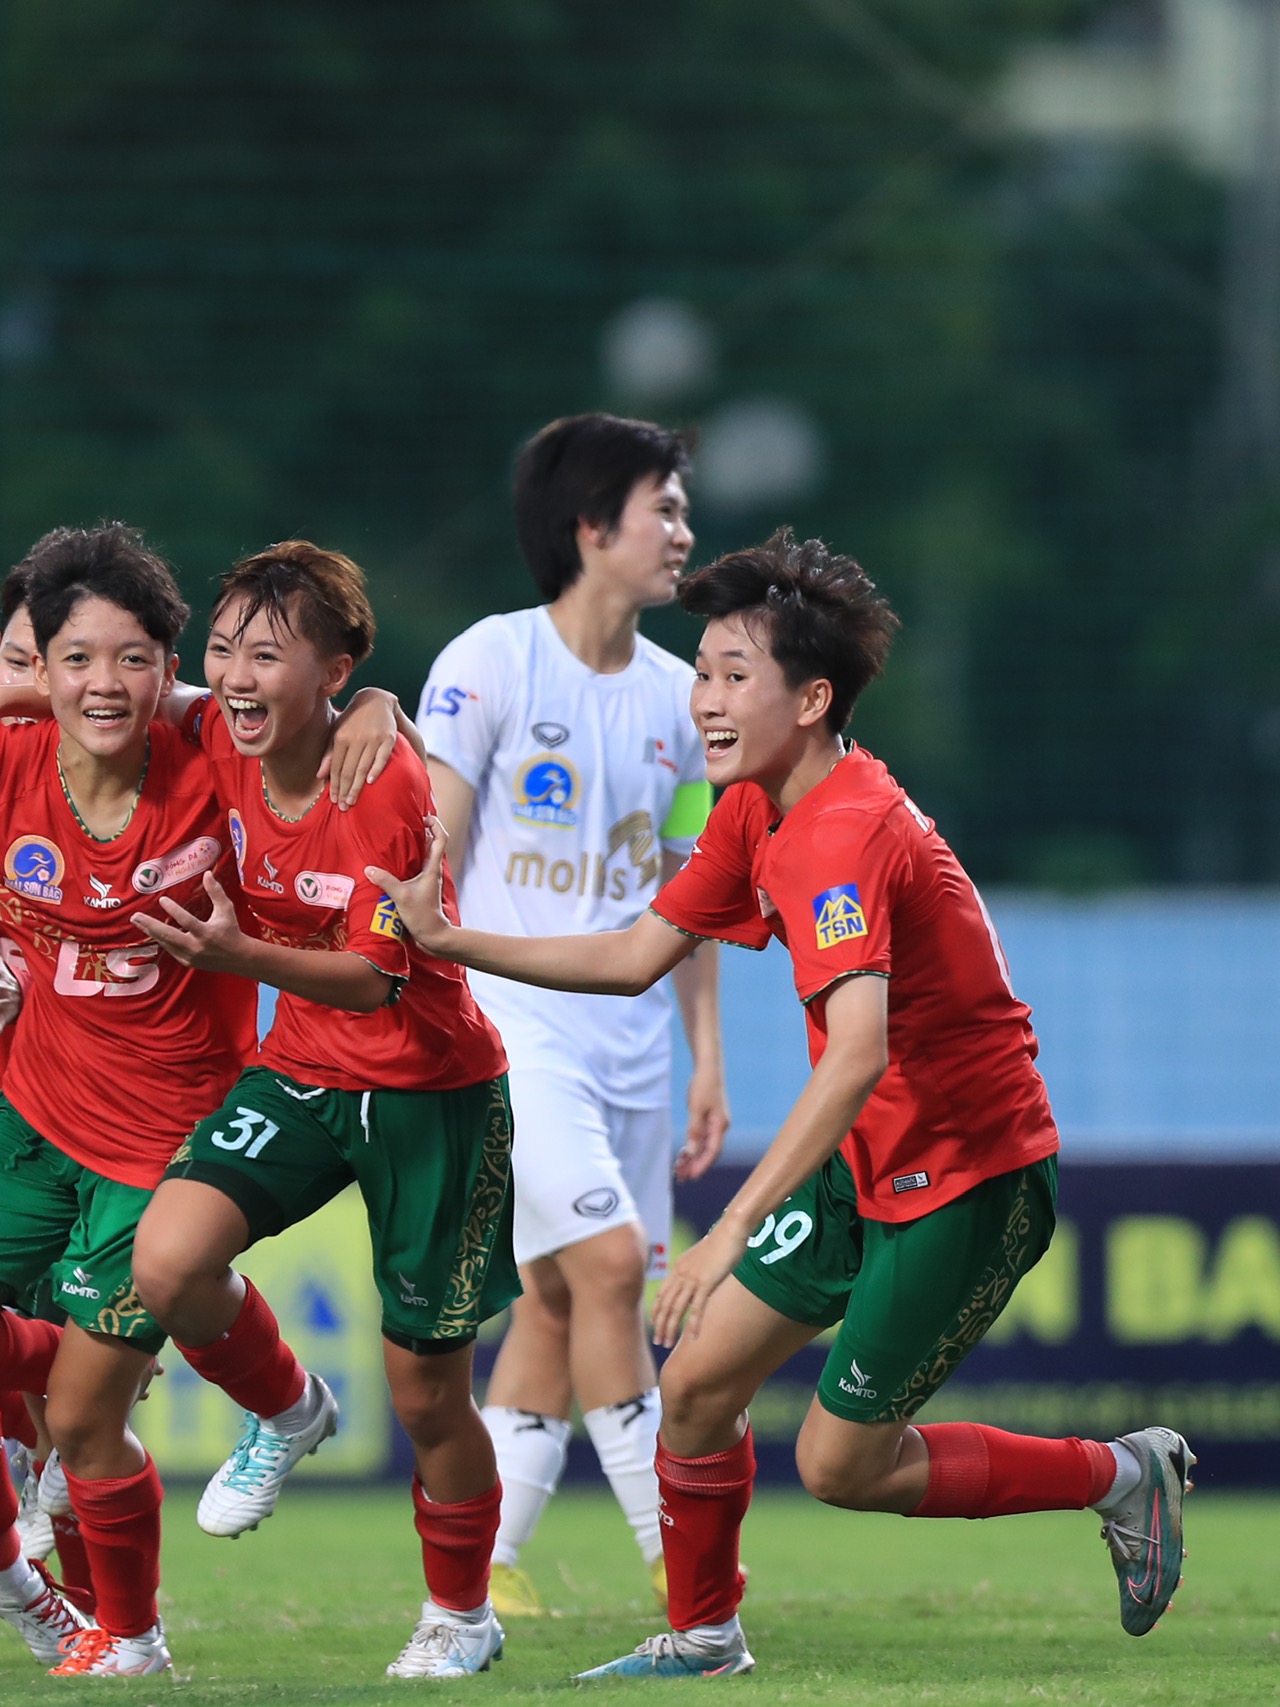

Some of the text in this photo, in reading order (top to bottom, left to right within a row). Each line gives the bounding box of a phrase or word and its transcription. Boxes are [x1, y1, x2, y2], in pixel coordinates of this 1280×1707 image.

[427, 687, 466, 717] LS
[83, 896, 121, 909] KAMITO
[820, 916, 864, 944] TSN
[53, 940, 161, 997] LS
[211, 1106, 280, 1159] 31
[61, 1281, 101, 1300] KAMITO
[838, 1377, 877, 1399] KAMITO
